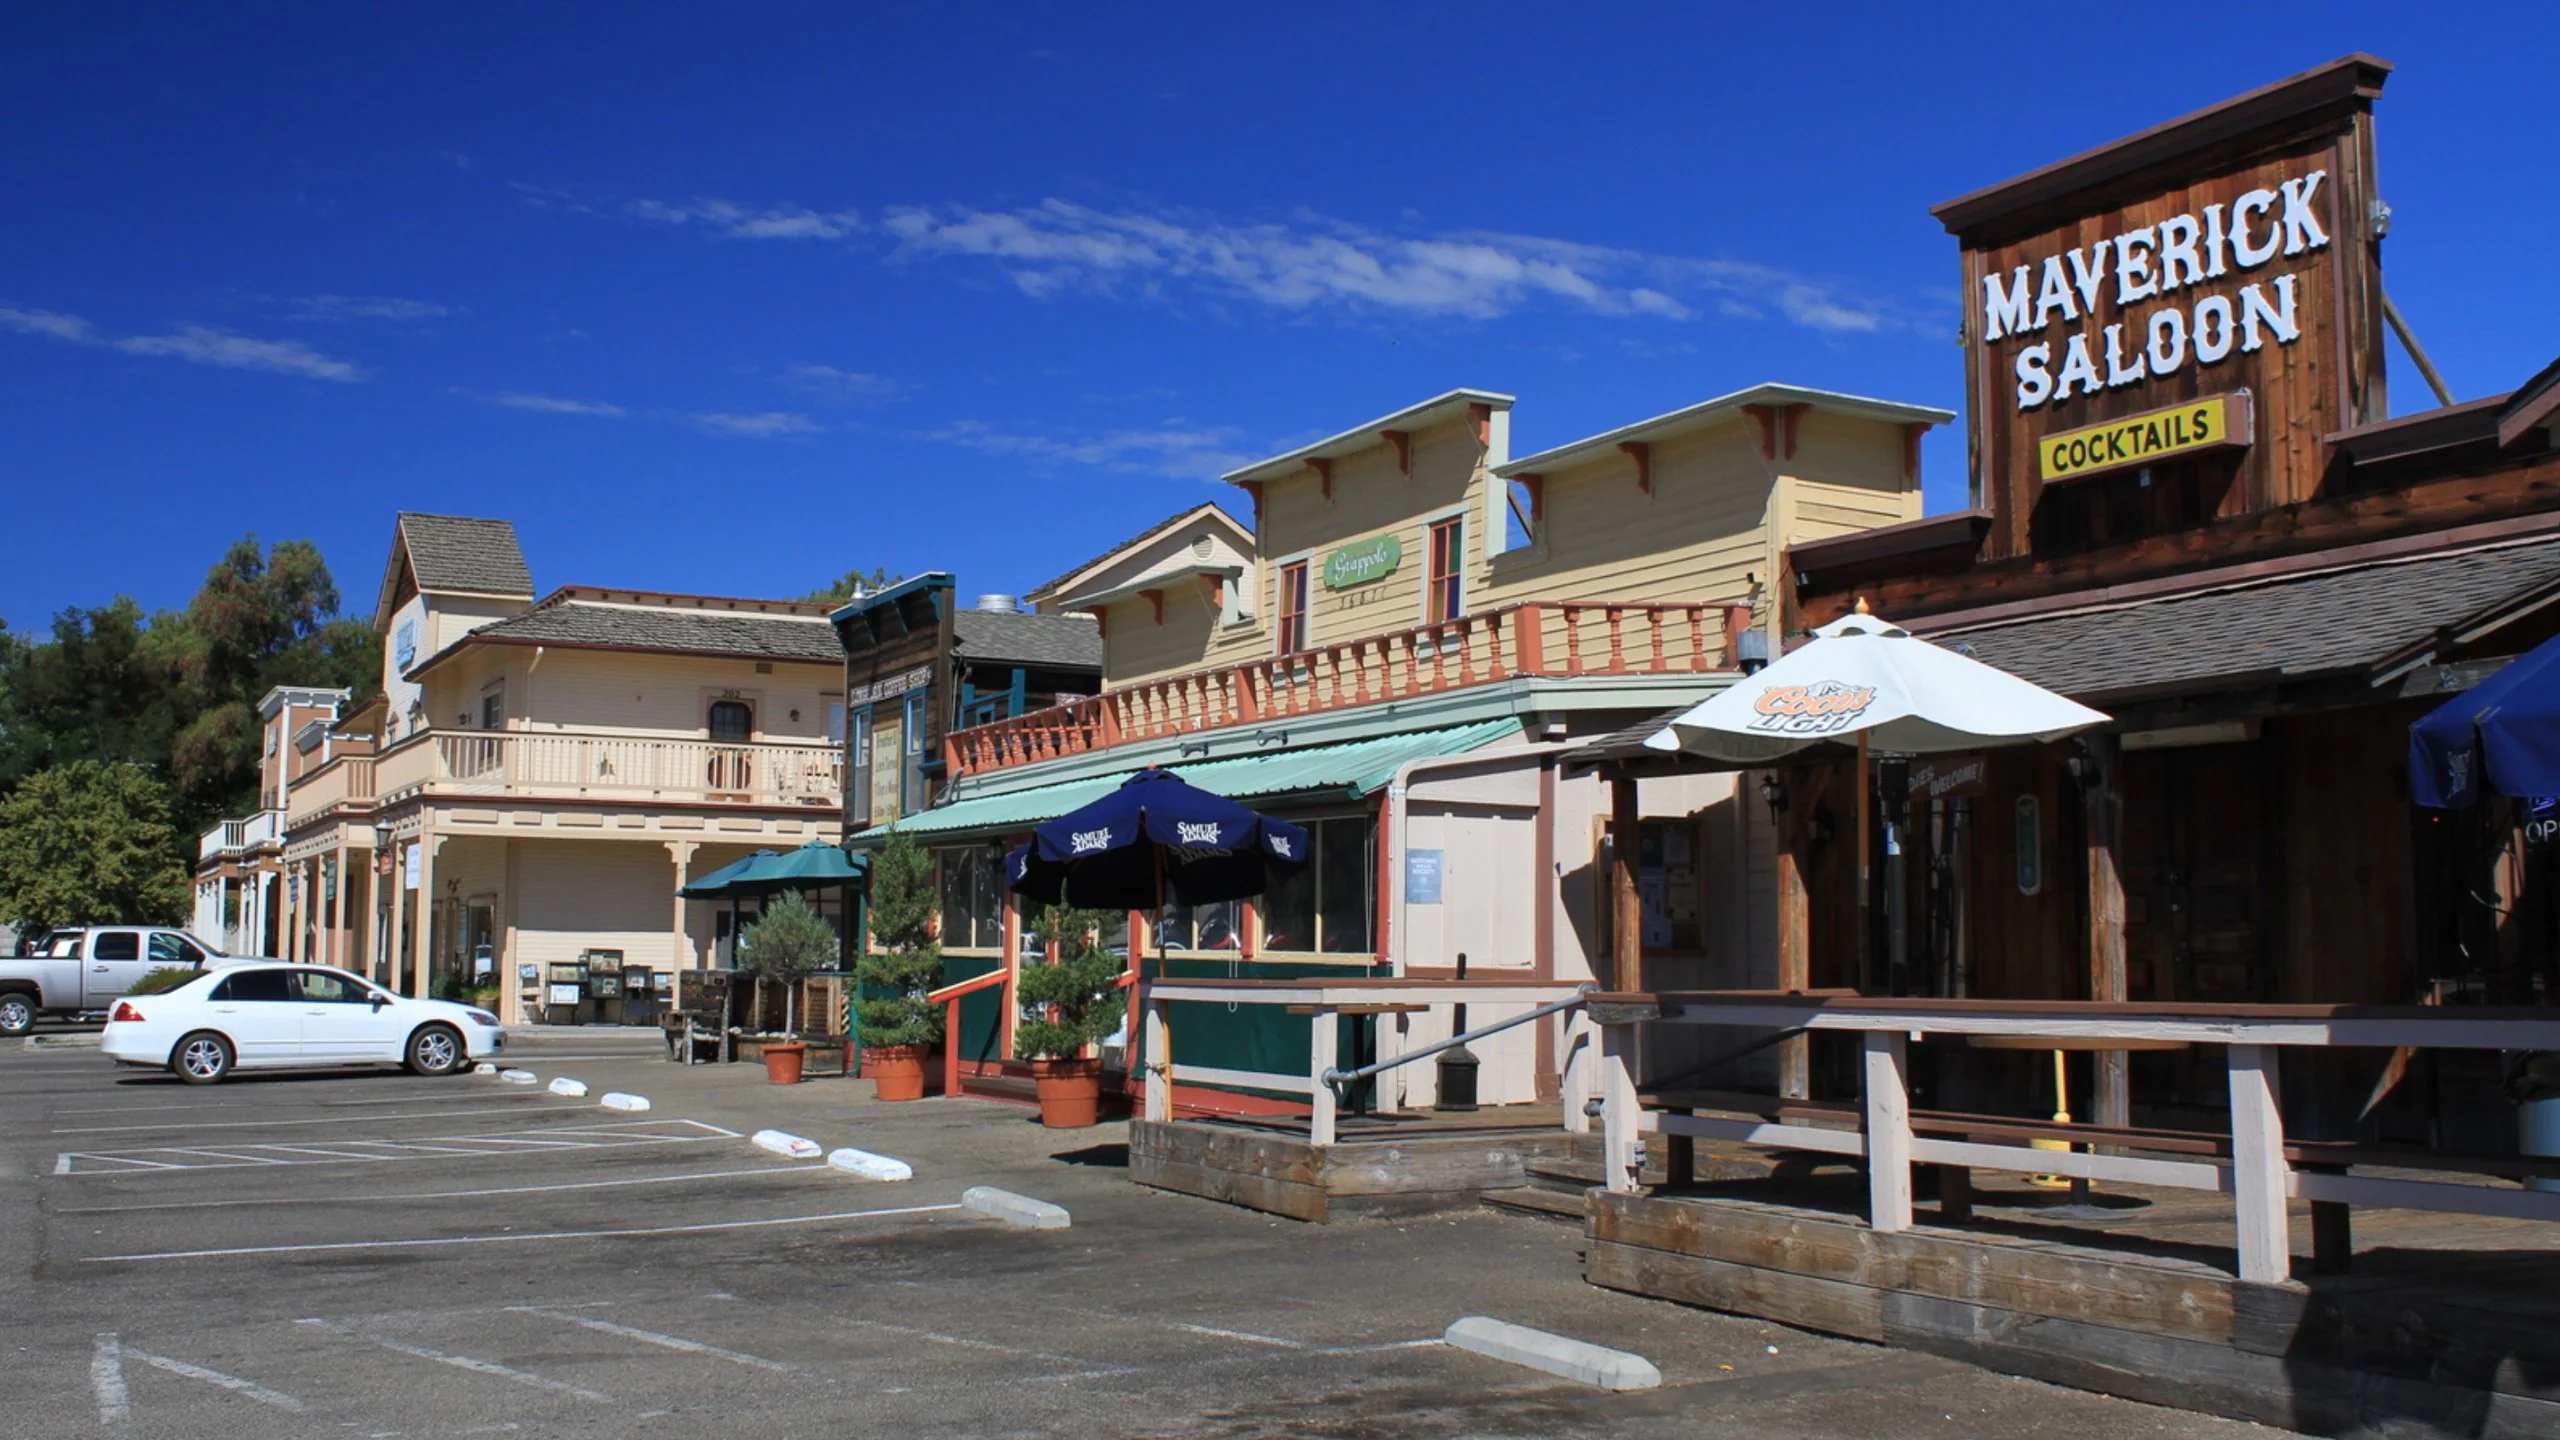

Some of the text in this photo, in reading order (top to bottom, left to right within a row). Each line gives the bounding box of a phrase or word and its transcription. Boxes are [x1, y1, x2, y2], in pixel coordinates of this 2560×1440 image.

[1984, 170, 2330, 342] MAVERICK
[2015, 273, 2300, 409] SALOON
[2053, 409, 2209, 472] COCKTAILS
[1335, 541, 1388, 581] Grappolo
[1753, 685, 1877, 716] Coors
[1747, 708, 1866, 733] LIGHT
[1908, 764, 1935, 793] DIES
[1071, 827, 1112, 846] SAMUEL
[1176, 821, 1222, 838] SAMUEL
[1182, 830, 1219, 844] ADAMS
[2525, 819, 2560, 844] OP
[1072, 838, 1108, 853] ADAMS
